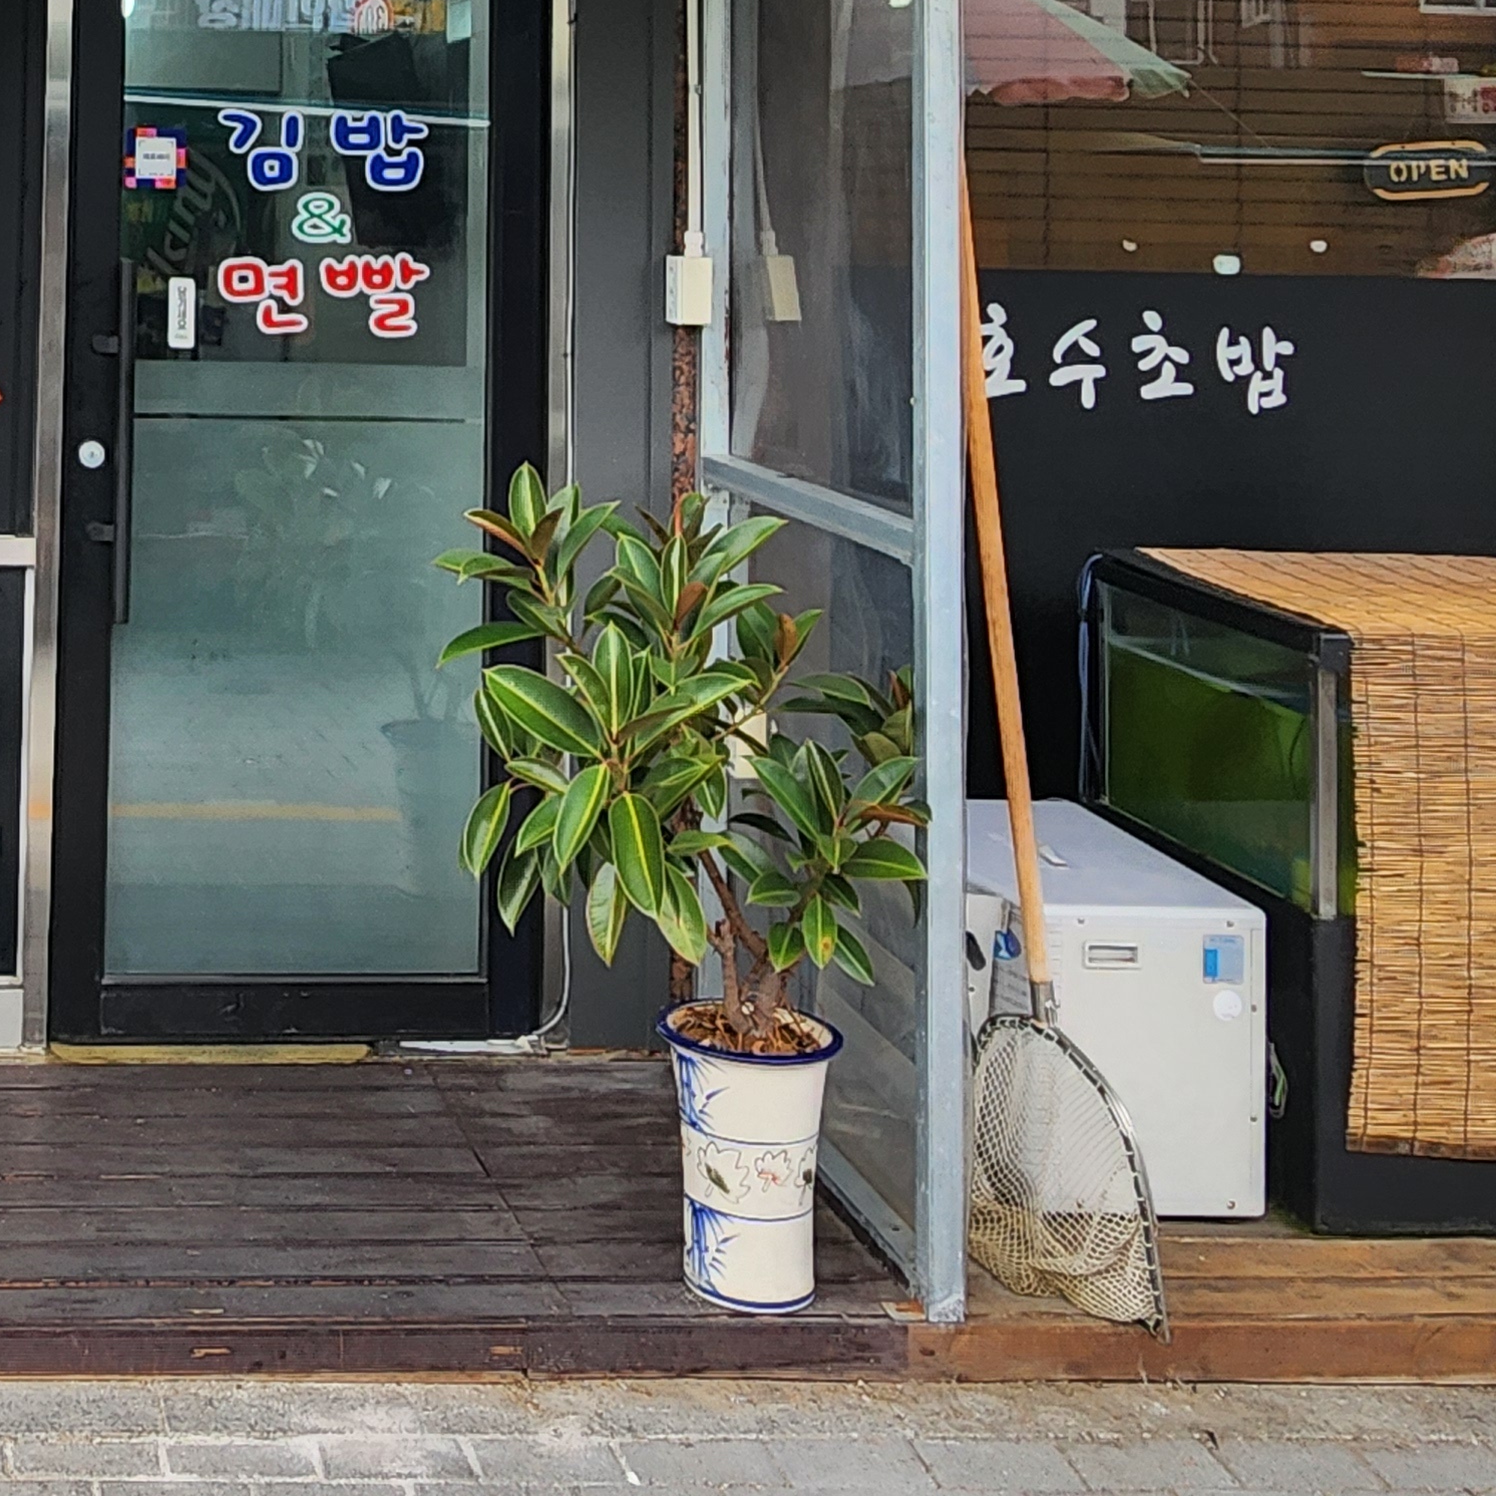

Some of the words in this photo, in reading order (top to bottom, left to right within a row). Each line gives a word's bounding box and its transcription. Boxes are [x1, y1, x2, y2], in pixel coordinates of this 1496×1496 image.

[220, 110, 426, 189] 김밥
[1389, 157, 1469, 183] OPEN
[293, 194, 350, 242] &
[219, 255, 427, 335] 면빨
[980, 301, 1295, 415] 호수초밥
